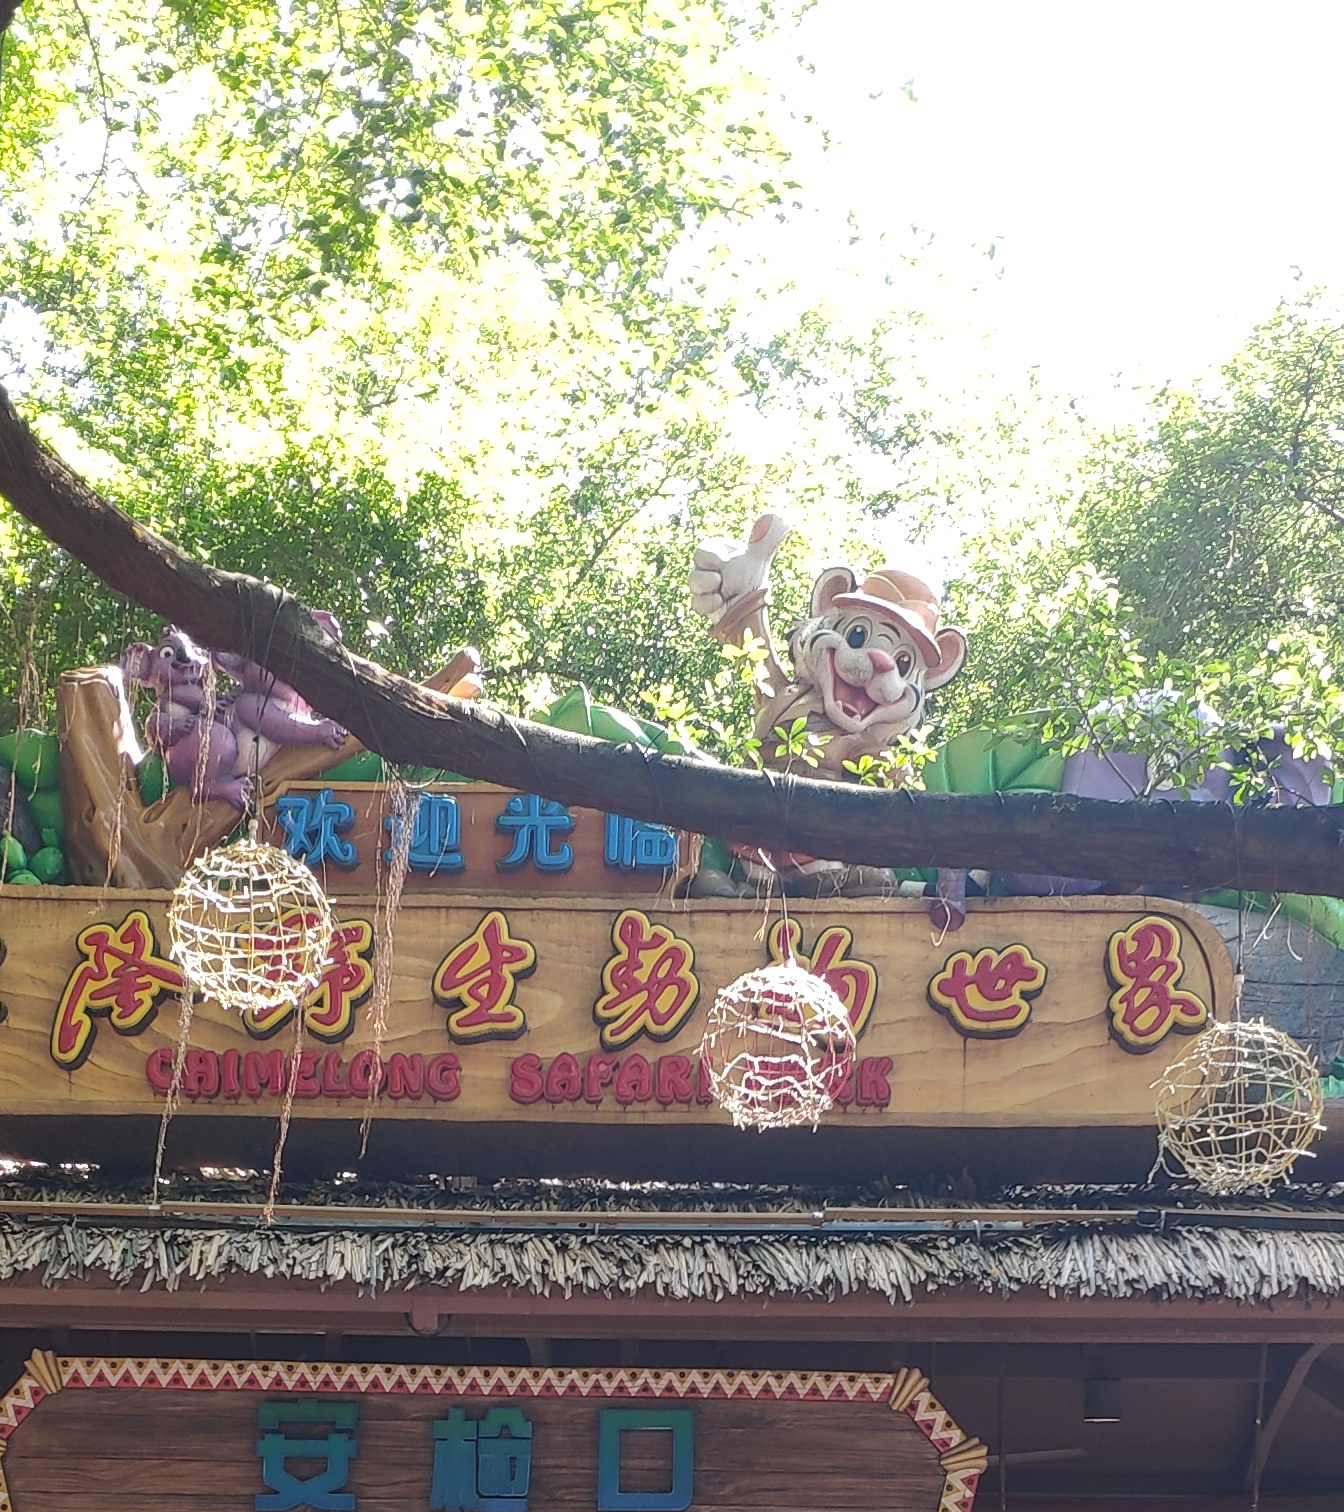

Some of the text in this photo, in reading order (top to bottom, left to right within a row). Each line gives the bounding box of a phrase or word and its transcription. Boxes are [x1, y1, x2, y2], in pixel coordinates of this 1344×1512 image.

[276, 787, 679, 873] 欢迎光临
[146, 1047, 461, 1100] CHIMELONG
